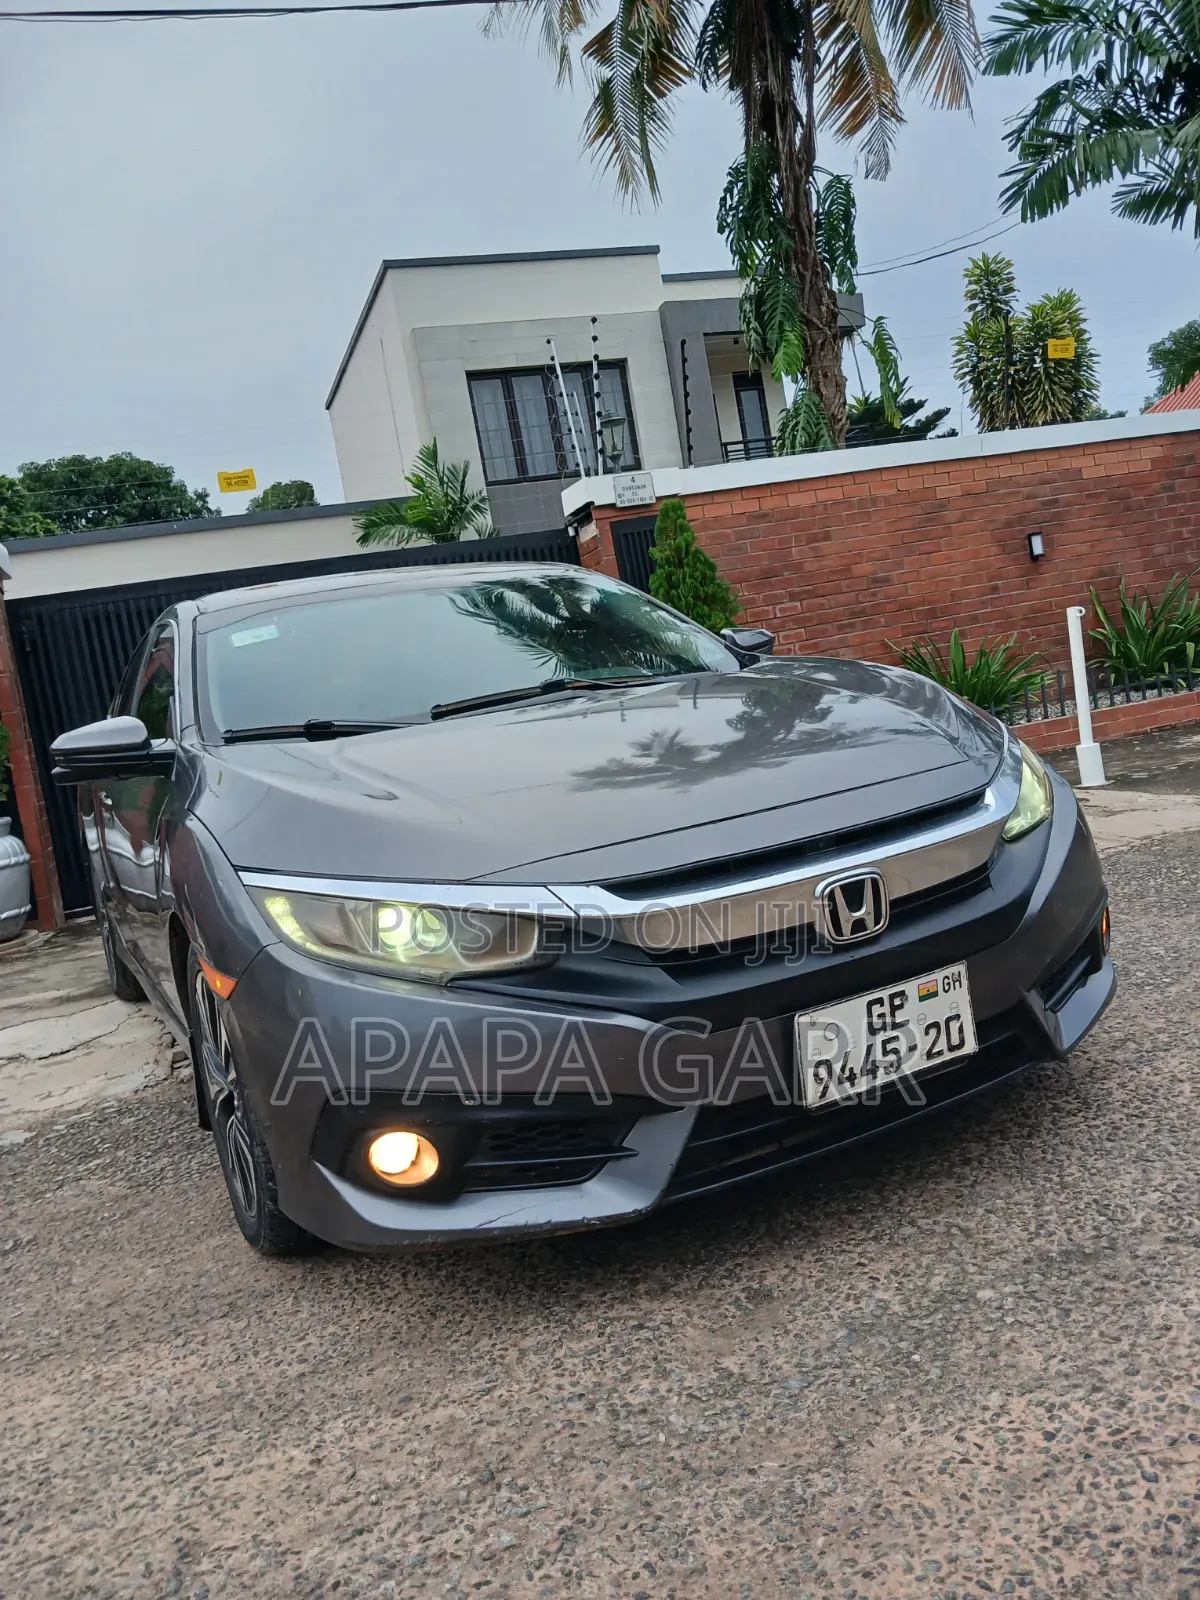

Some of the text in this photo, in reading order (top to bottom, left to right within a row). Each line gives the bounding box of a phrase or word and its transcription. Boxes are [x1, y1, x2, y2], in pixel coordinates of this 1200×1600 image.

[942, 970, 962, 994] GH
[866, 989, 910, 1037] GE
[813, 1013, 966, 1100] 9445-20
